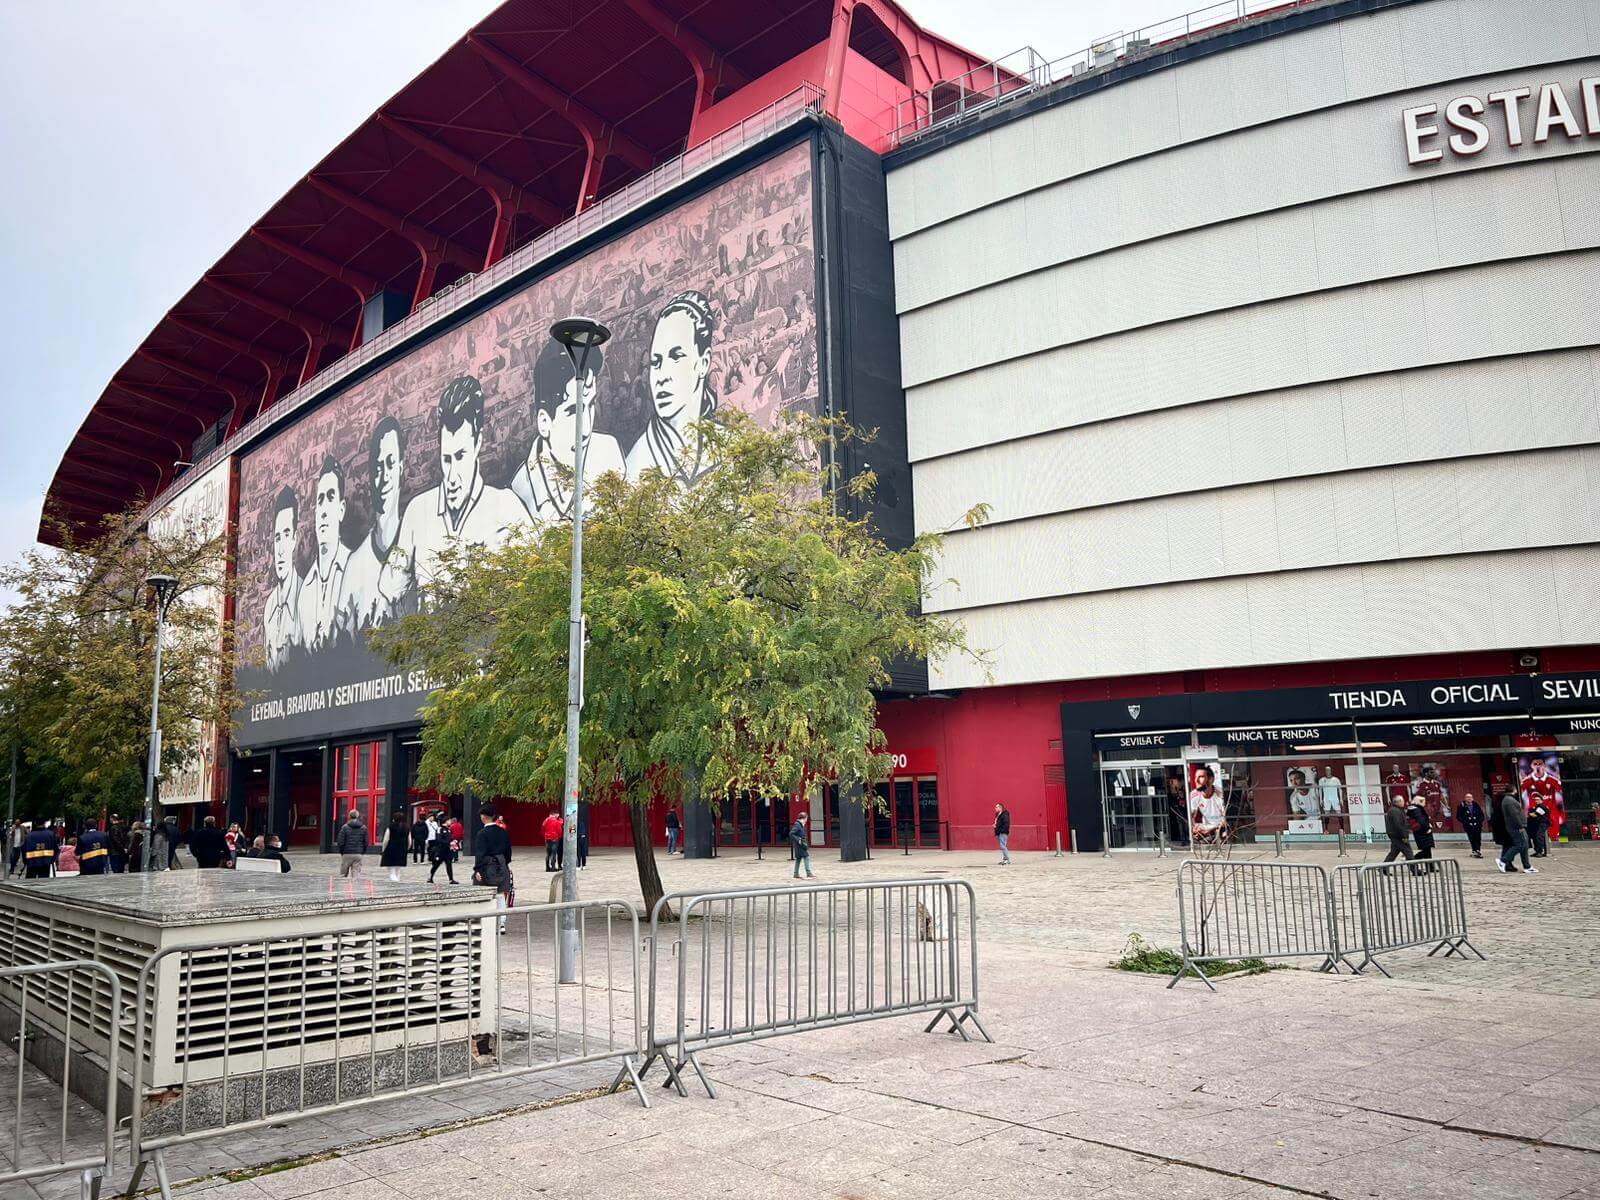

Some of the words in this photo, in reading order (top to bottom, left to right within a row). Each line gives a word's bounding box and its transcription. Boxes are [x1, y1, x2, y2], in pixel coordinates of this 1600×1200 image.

[251, 699, 285, 722] LEYENDA,
[286, 689, 325, 716] BRAVURA
[327, 688, 334, 708] Y
[335, 674, 405, 706] SENTIMIENTO.
[1329, 690, 1406, 710] TIENDA
[1431, 684, 1519, 705] OFICIAL
[1228, 731, 1263, 742] NUNCA
[1266, 730, 1279, 740] TE
[1281, 728, 1320, 740] RINDAS
[1412, 724, 1454, 736] SEVILLA
[1456, 723, 1470, 734] FC
[1120, 736, 1152, 747] SEVILLA
[1153, 735, 1166, 745] FC
